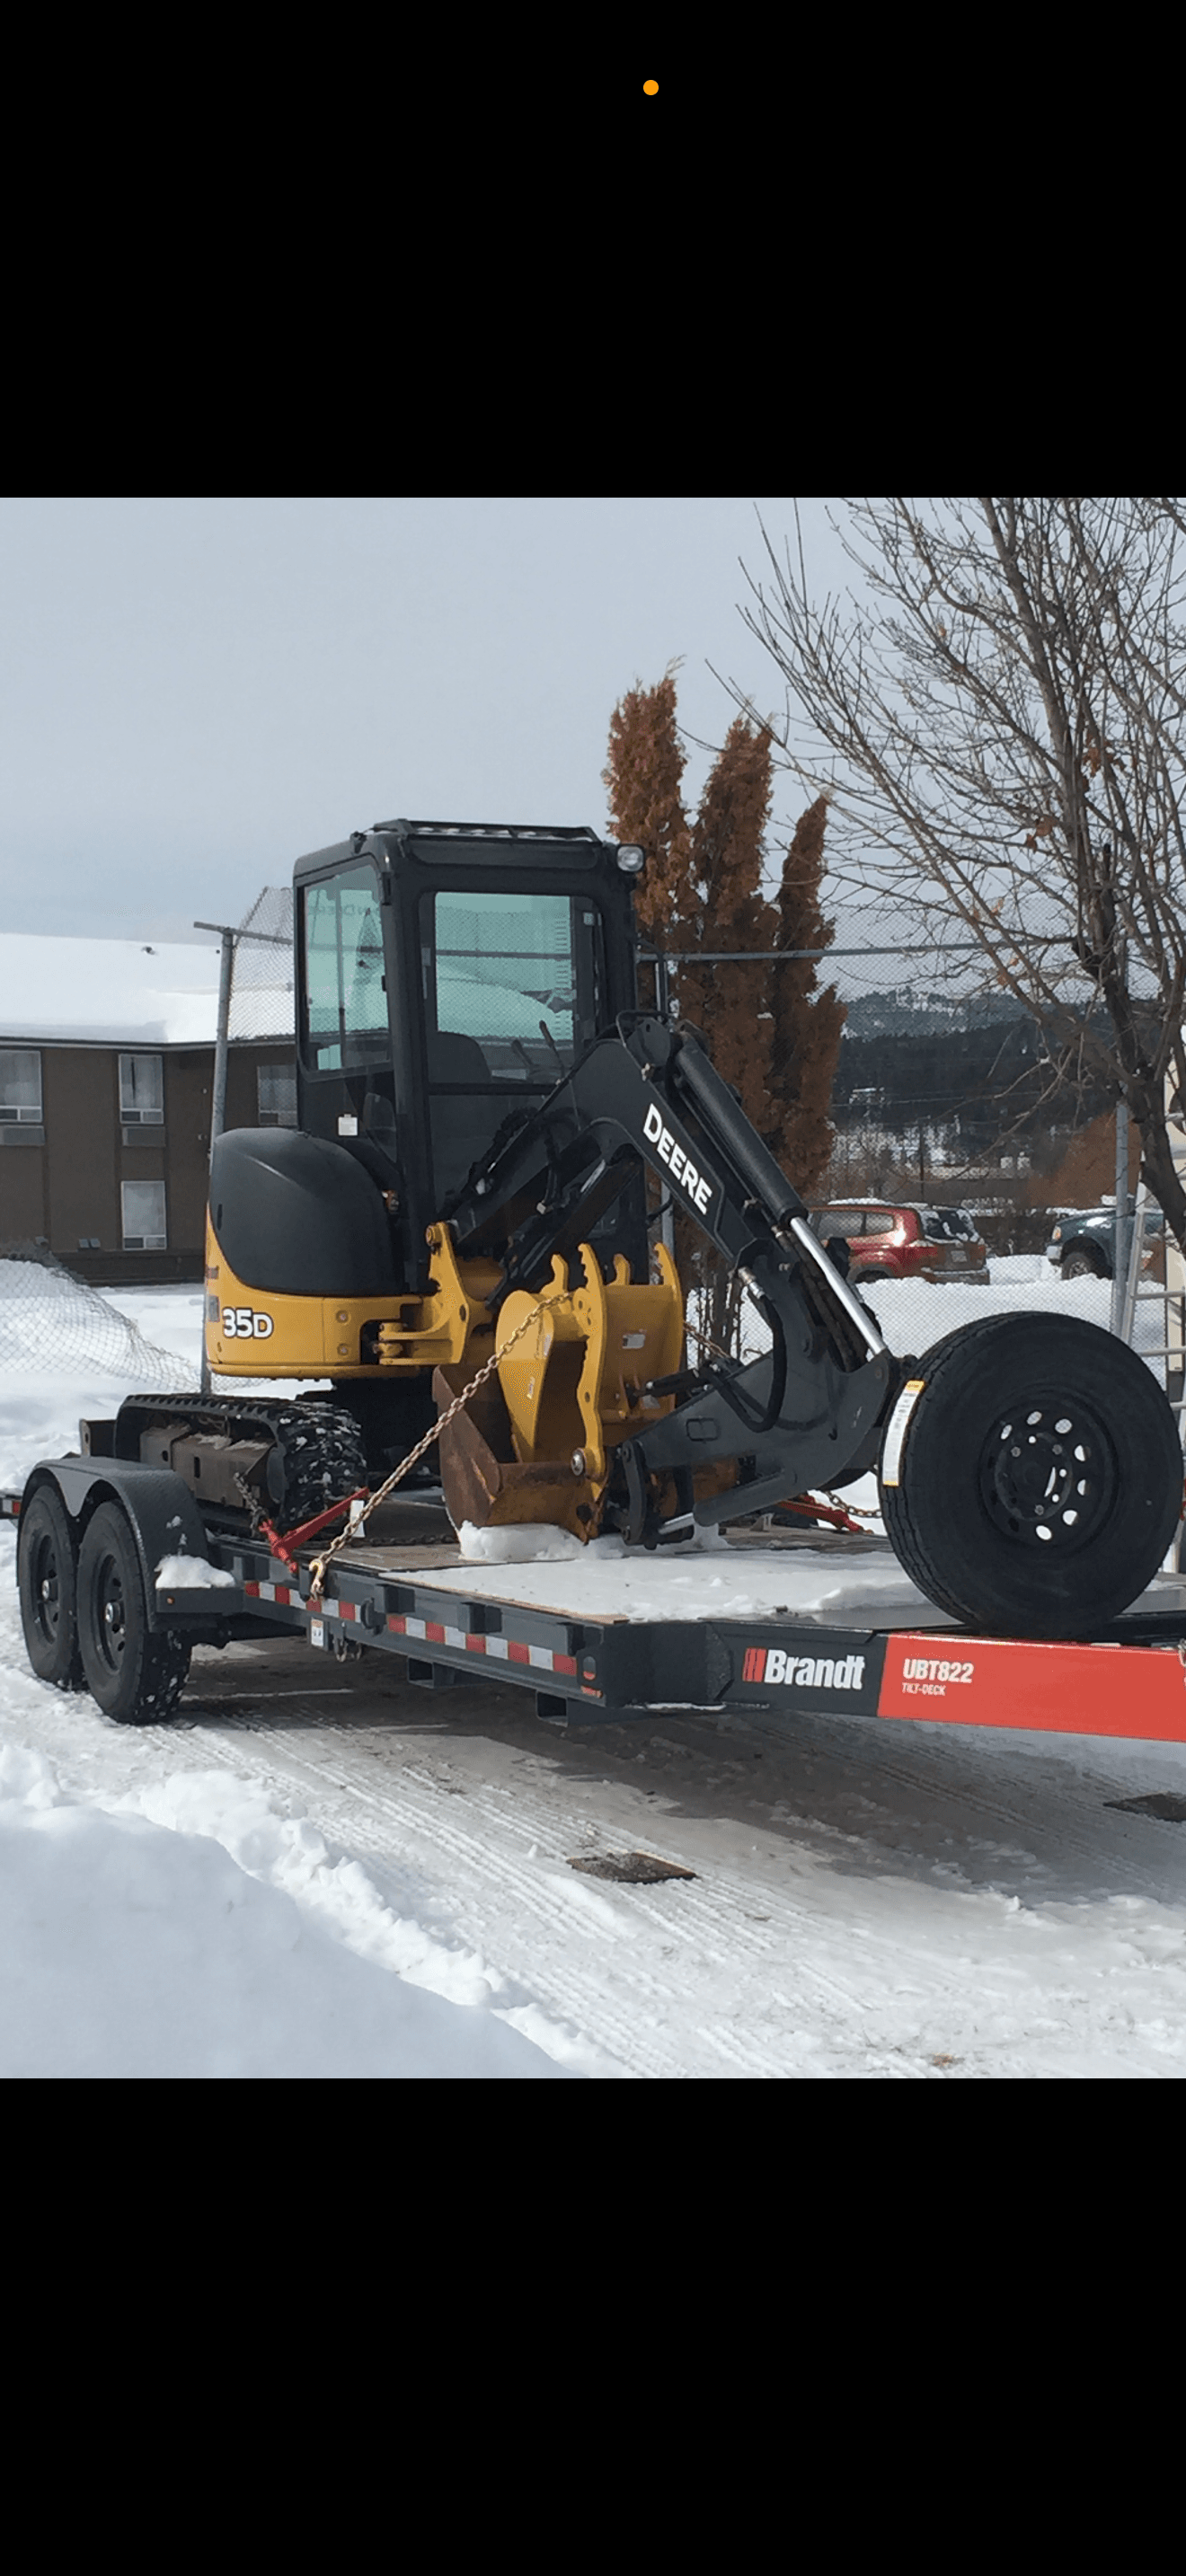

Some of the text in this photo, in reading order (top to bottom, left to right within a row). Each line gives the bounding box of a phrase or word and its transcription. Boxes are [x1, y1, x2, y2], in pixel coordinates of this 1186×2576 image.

[642, 1102, 713, 1216] DEERE
[222, 1307, 274, 1339] 35D
[764, 1649, 865, 1690] Brandt
[902, 1657, 974, 1684] UBT822
[901, 1681, 946, 1696] TILT-DECK
